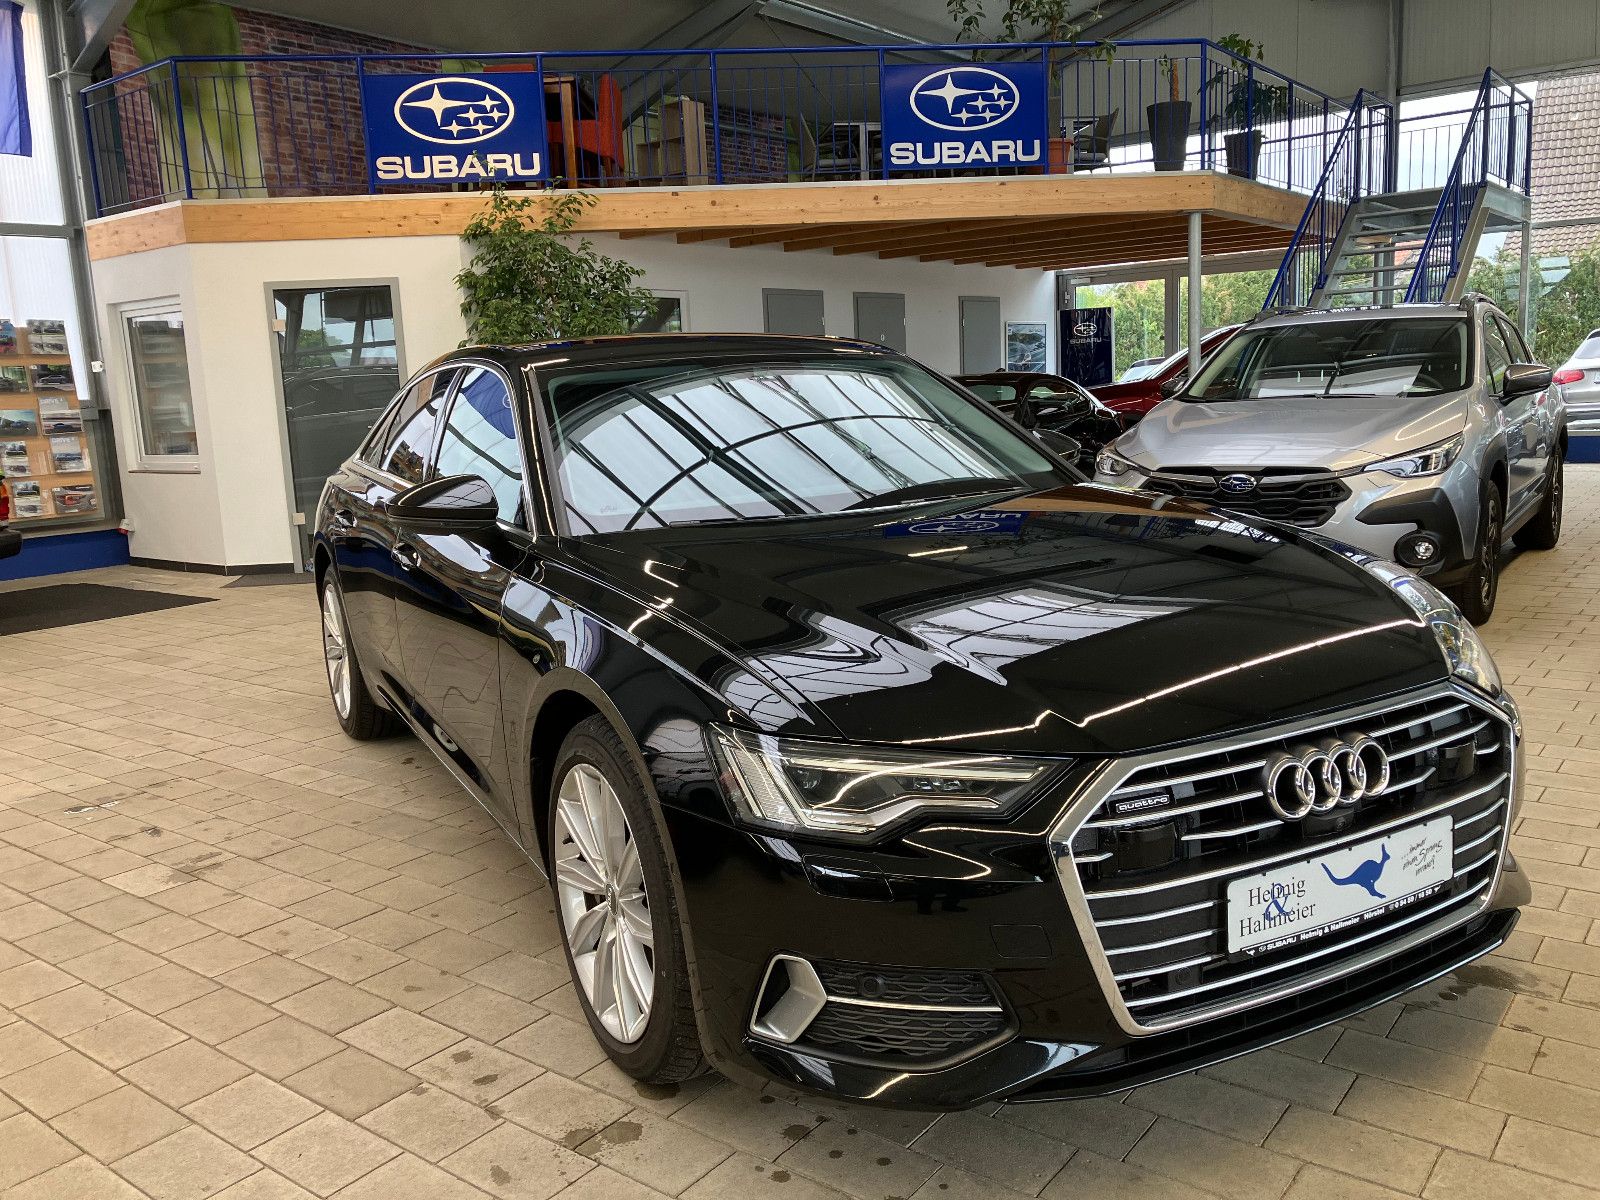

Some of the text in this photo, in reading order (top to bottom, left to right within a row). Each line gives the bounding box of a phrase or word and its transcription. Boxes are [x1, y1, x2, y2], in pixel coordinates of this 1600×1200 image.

[889, 139, 1041, 165] SUBARU
[375, 152, 541, 180] SUBARU
[1069, 337, 1102, 345] SUBARU
[1119, 797, 1168, 811] quattro
[1248, 877, 1306, 907] Helmig
[1264, 882, 1294, 922] &
[1240, 903, 1316, 937] Hallmeier
[1266, 936, 1297, 951] SUBARU
[1300, 929, 1323, 941] Helmig
